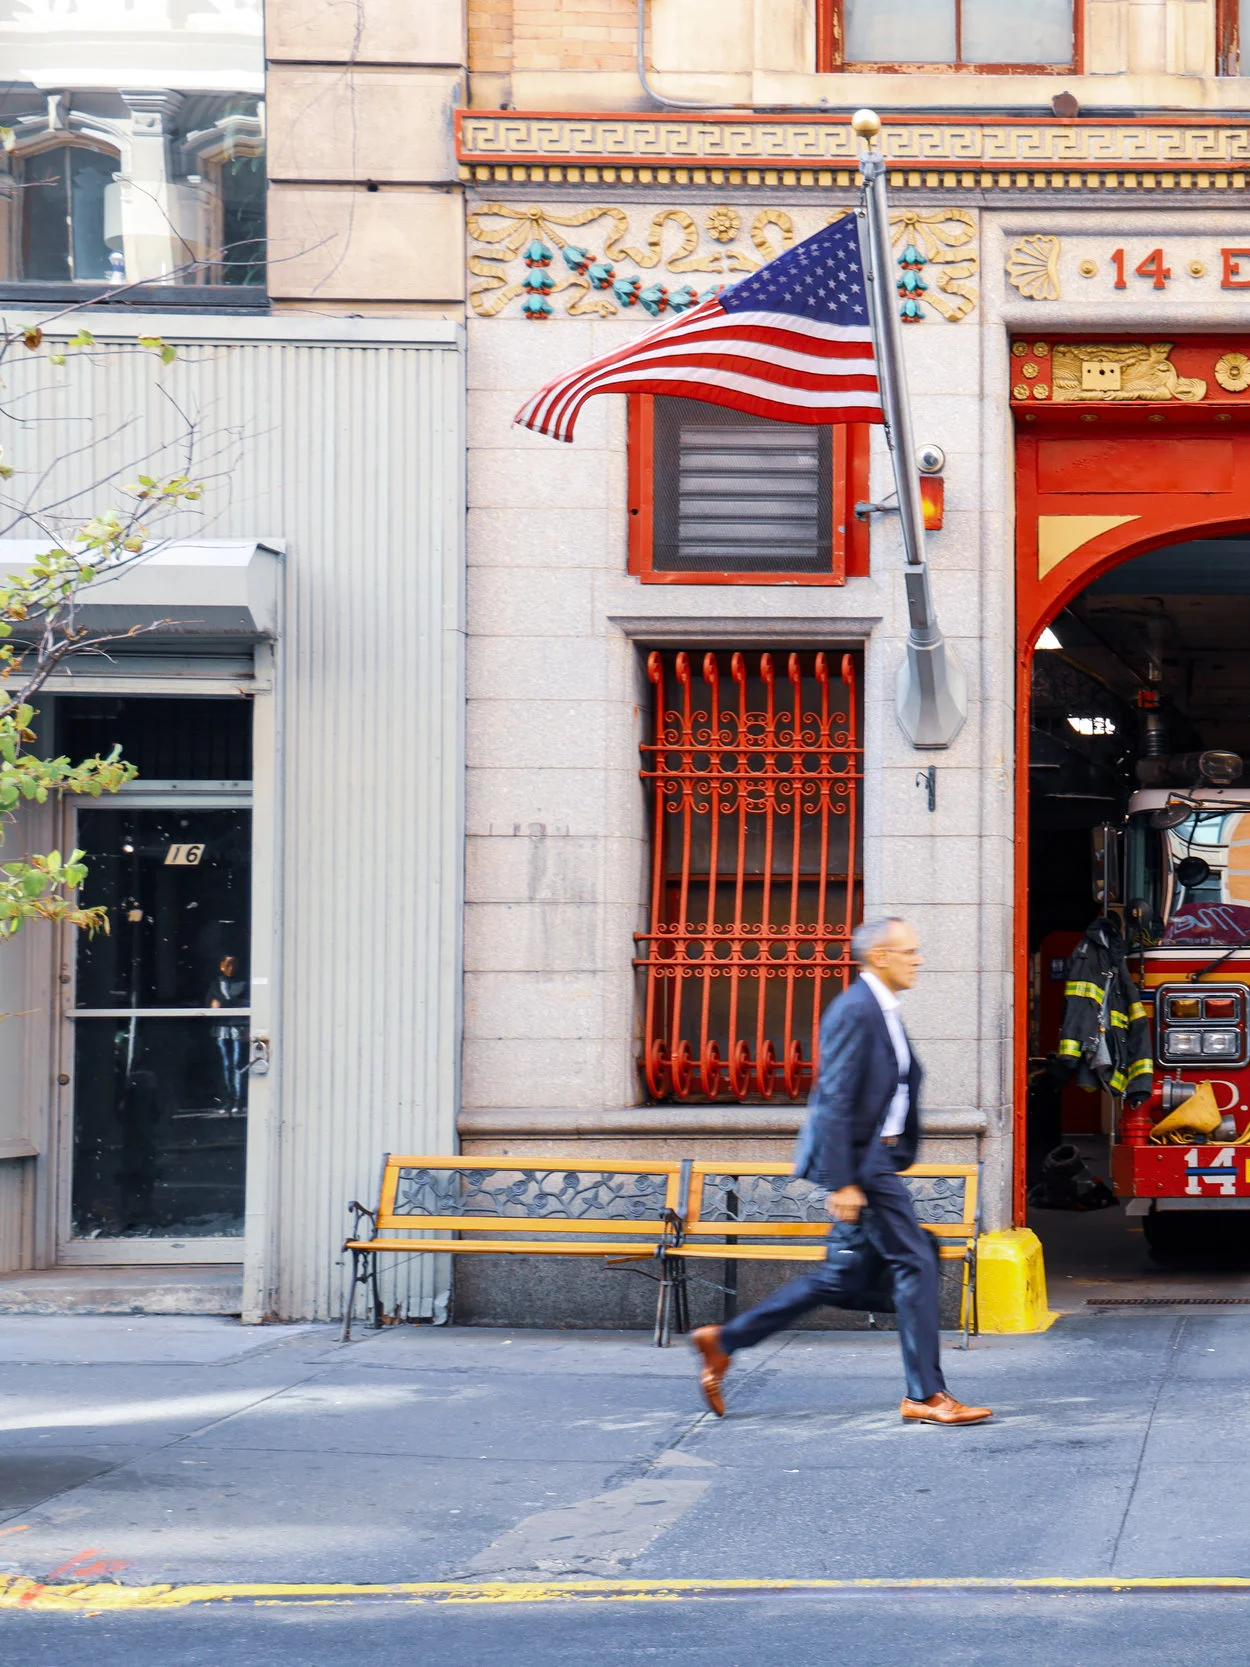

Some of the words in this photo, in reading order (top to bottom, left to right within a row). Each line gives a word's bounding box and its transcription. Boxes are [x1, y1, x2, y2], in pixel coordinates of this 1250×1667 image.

[1110, 248, 1172, 289] 14
[172, 845, 201, 864] 16
[1184, 1148, 1238, 1195] 14
